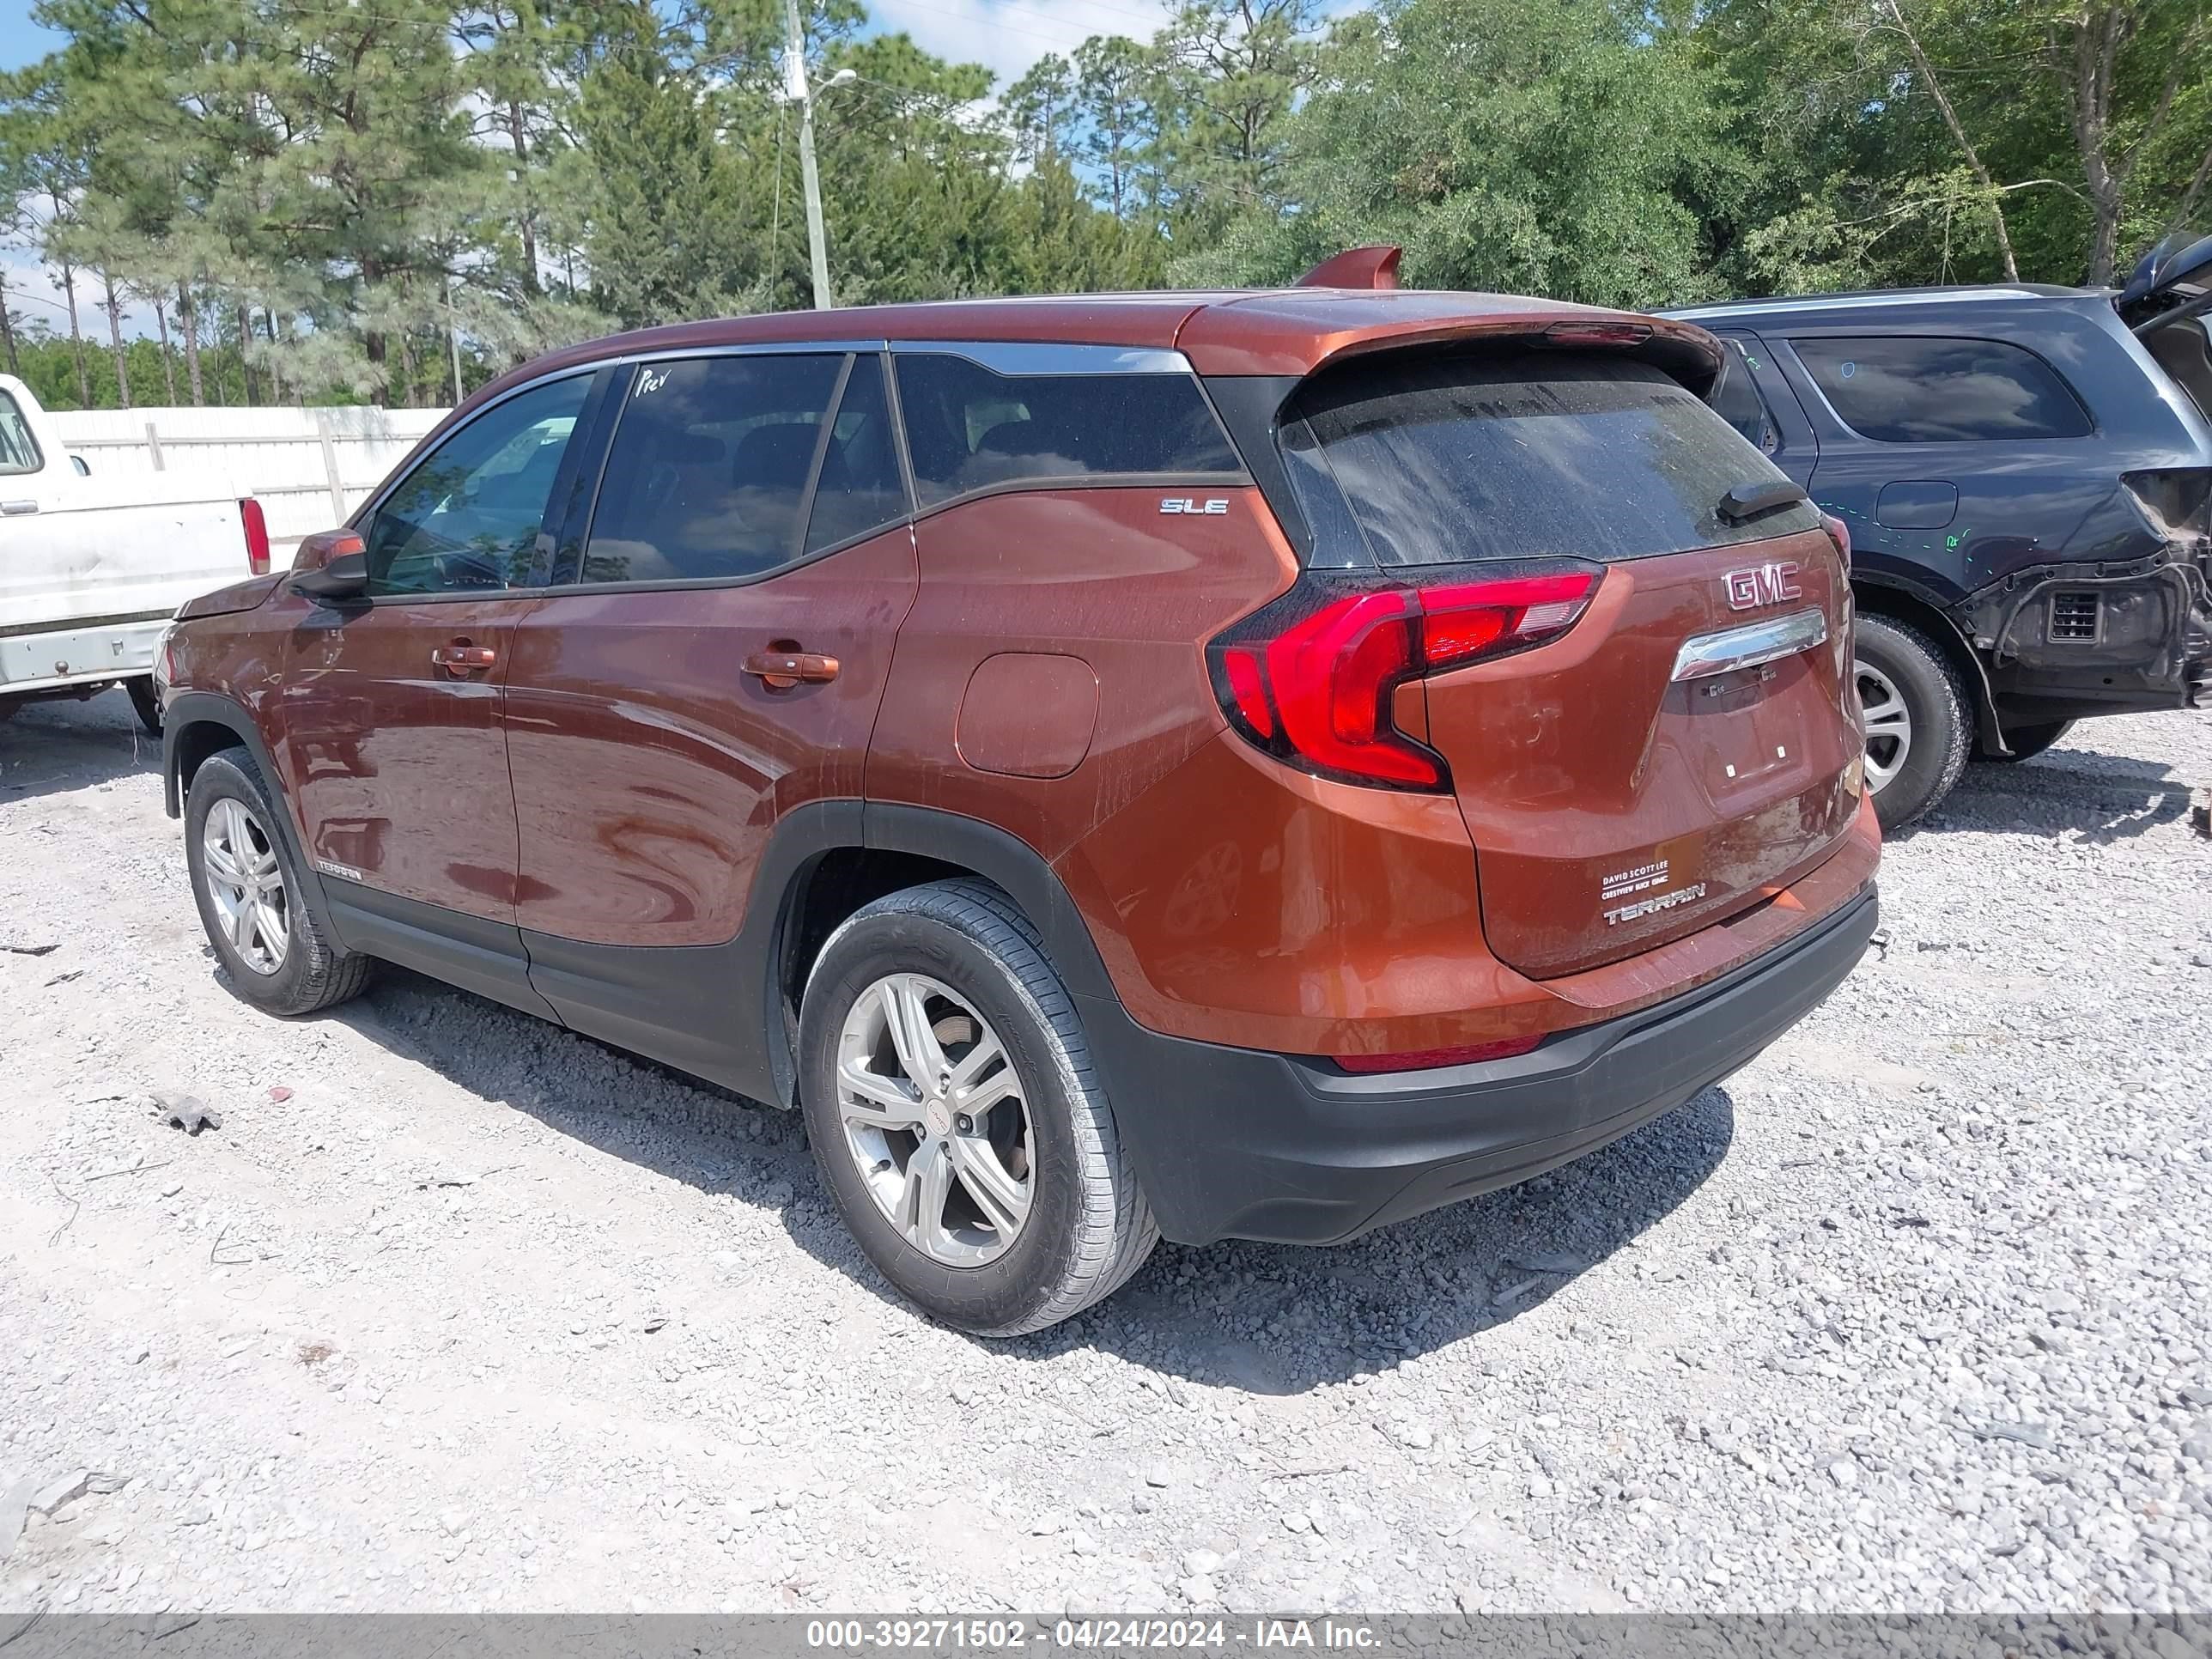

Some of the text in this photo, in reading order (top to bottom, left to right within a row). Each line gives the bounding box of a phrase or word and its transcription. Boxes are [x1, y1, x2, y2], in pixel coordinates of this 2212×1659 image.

[1159, 498, 1230, 514] SLE
[1724, 561, 1802, 611] GMC
[1602, 860, 1668, 886] DAVID SCOTT LEE
[1601, 885, 1634, 901] CRESTVIEW
[1602, 883, 1707, 927] TERRAIN
